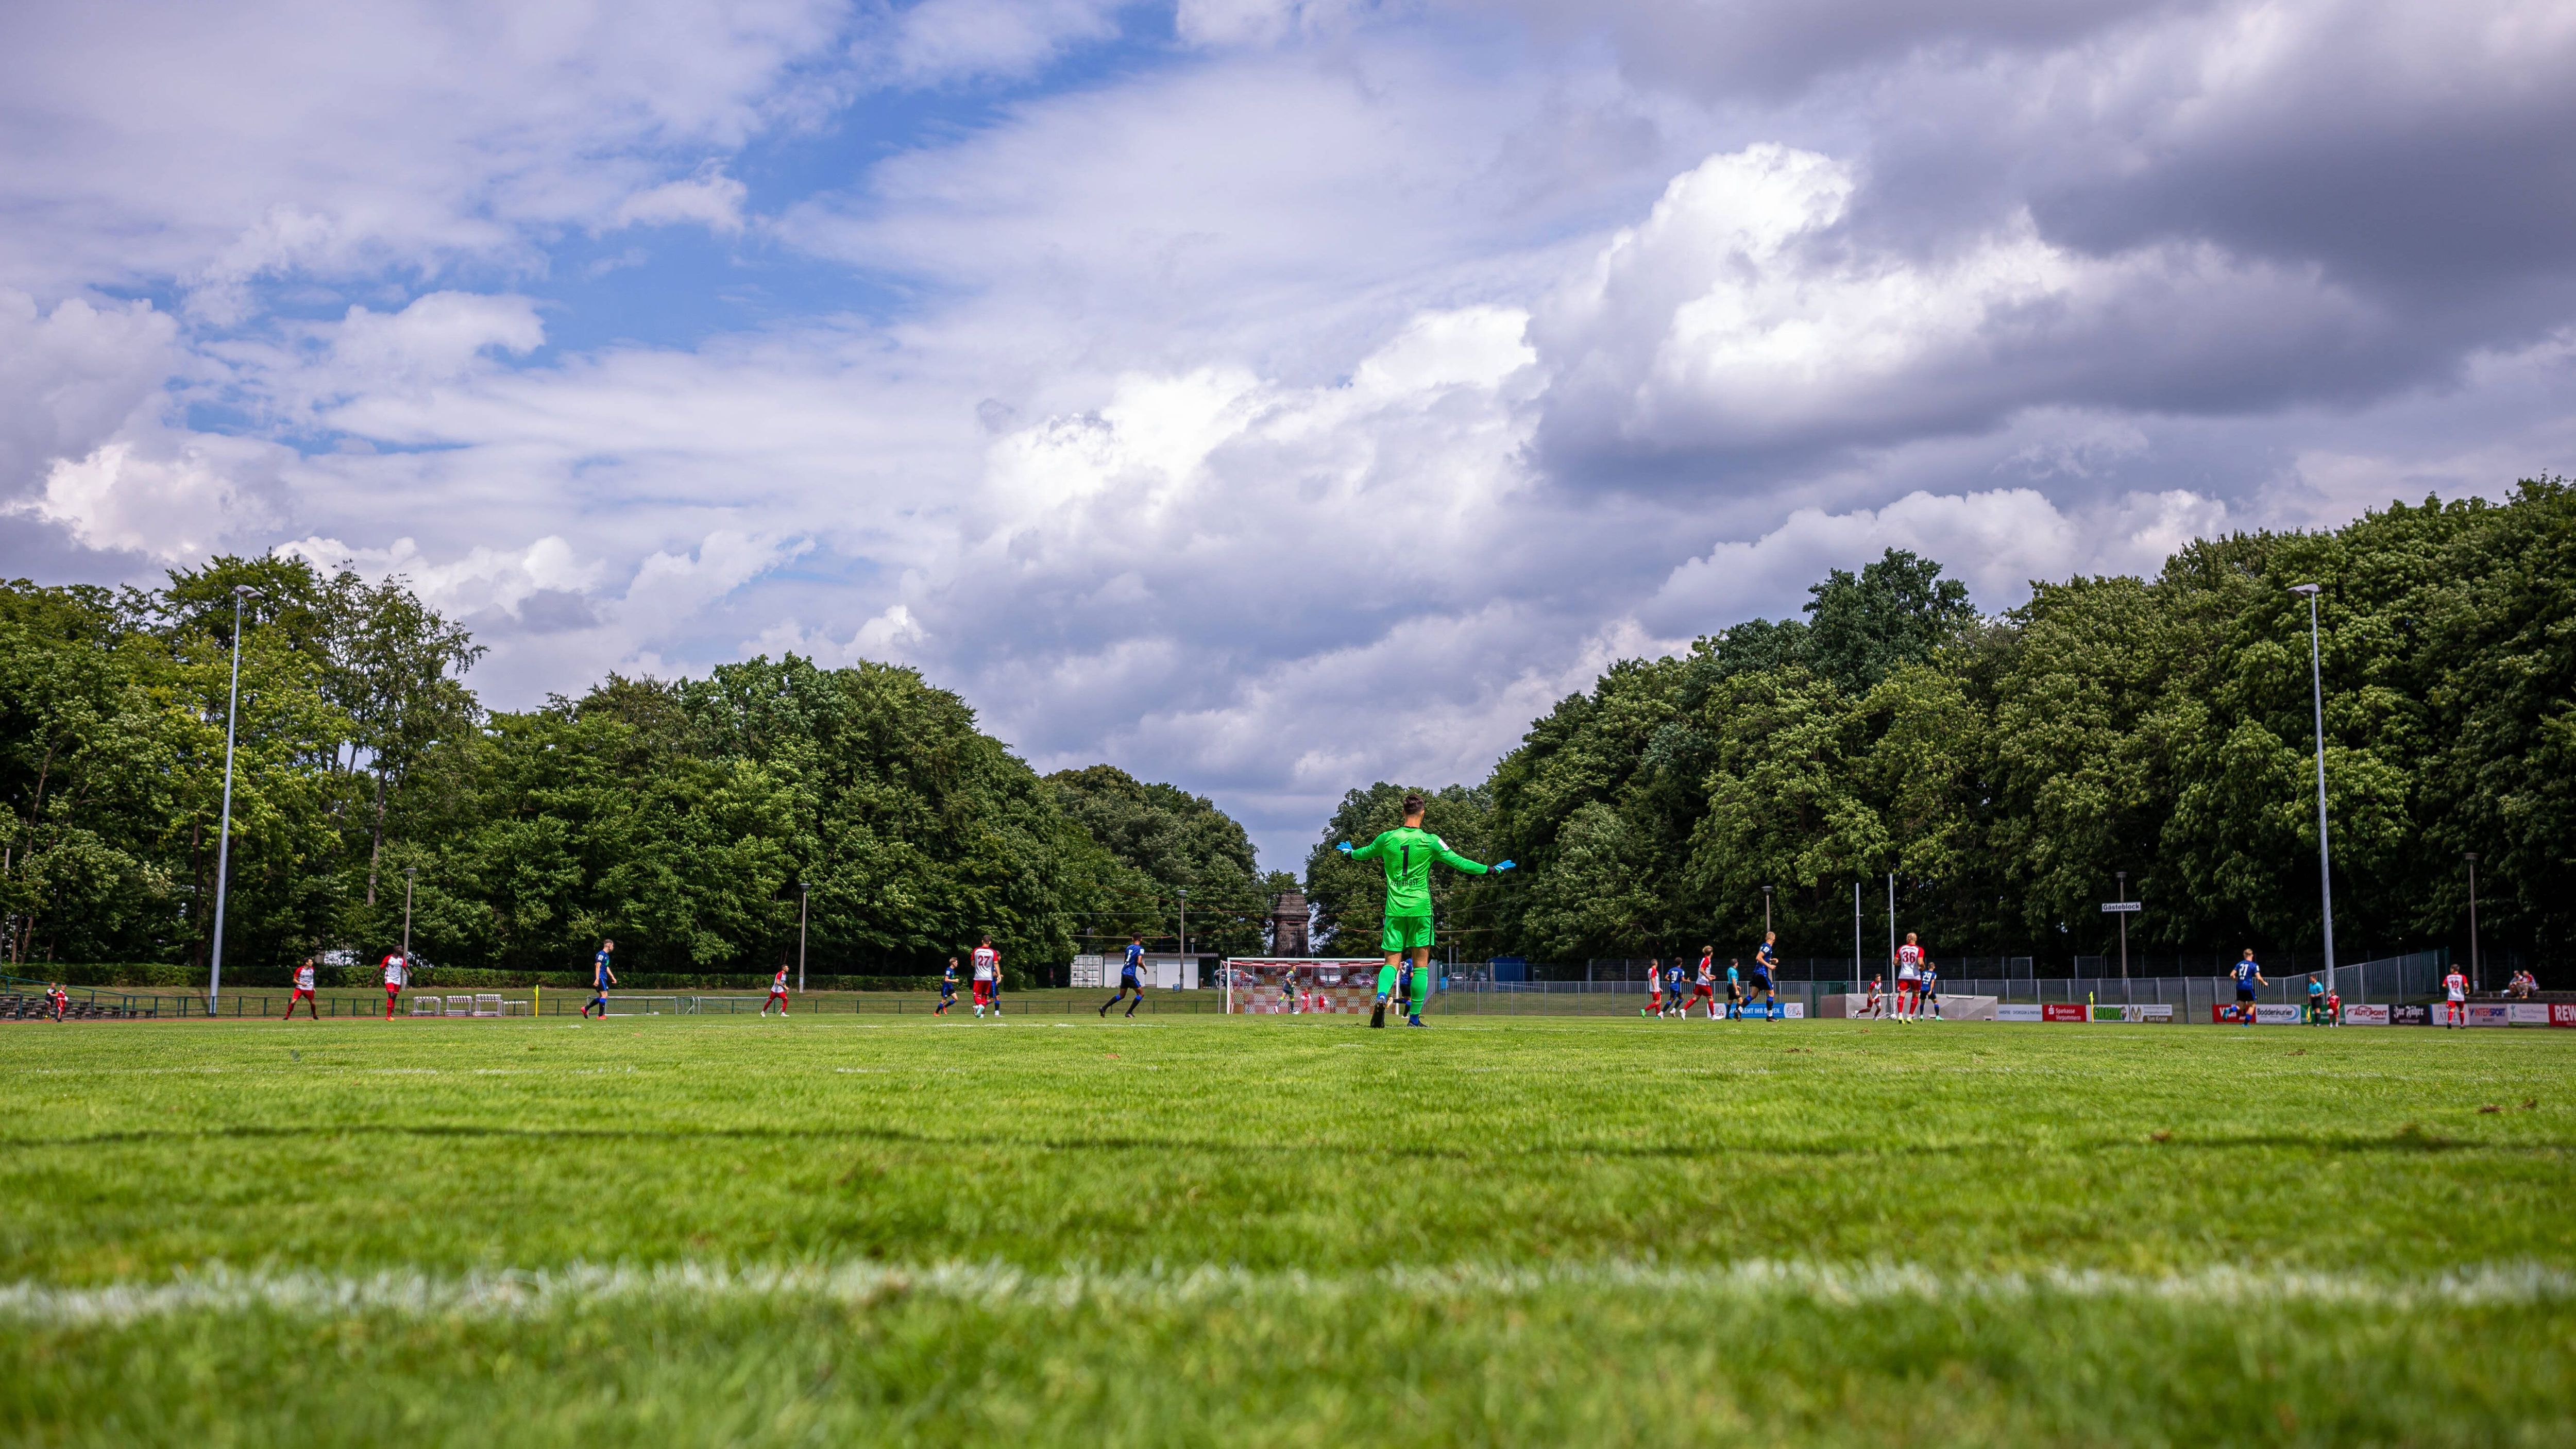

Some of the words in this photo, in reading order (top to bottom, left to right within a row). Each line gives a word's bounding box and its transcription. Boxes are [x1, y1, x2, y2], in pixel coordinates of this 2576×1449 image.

[1400, 845, 1410, 877] 1
[978, 955, 990, 966] 27
[1902, 951, 1916, 963] 36
[1922, 971, 1933, 982] 29
[2450, 980, 2459, 988] 19
[2475, 1008, 2505, 1016] INTERSPORT
